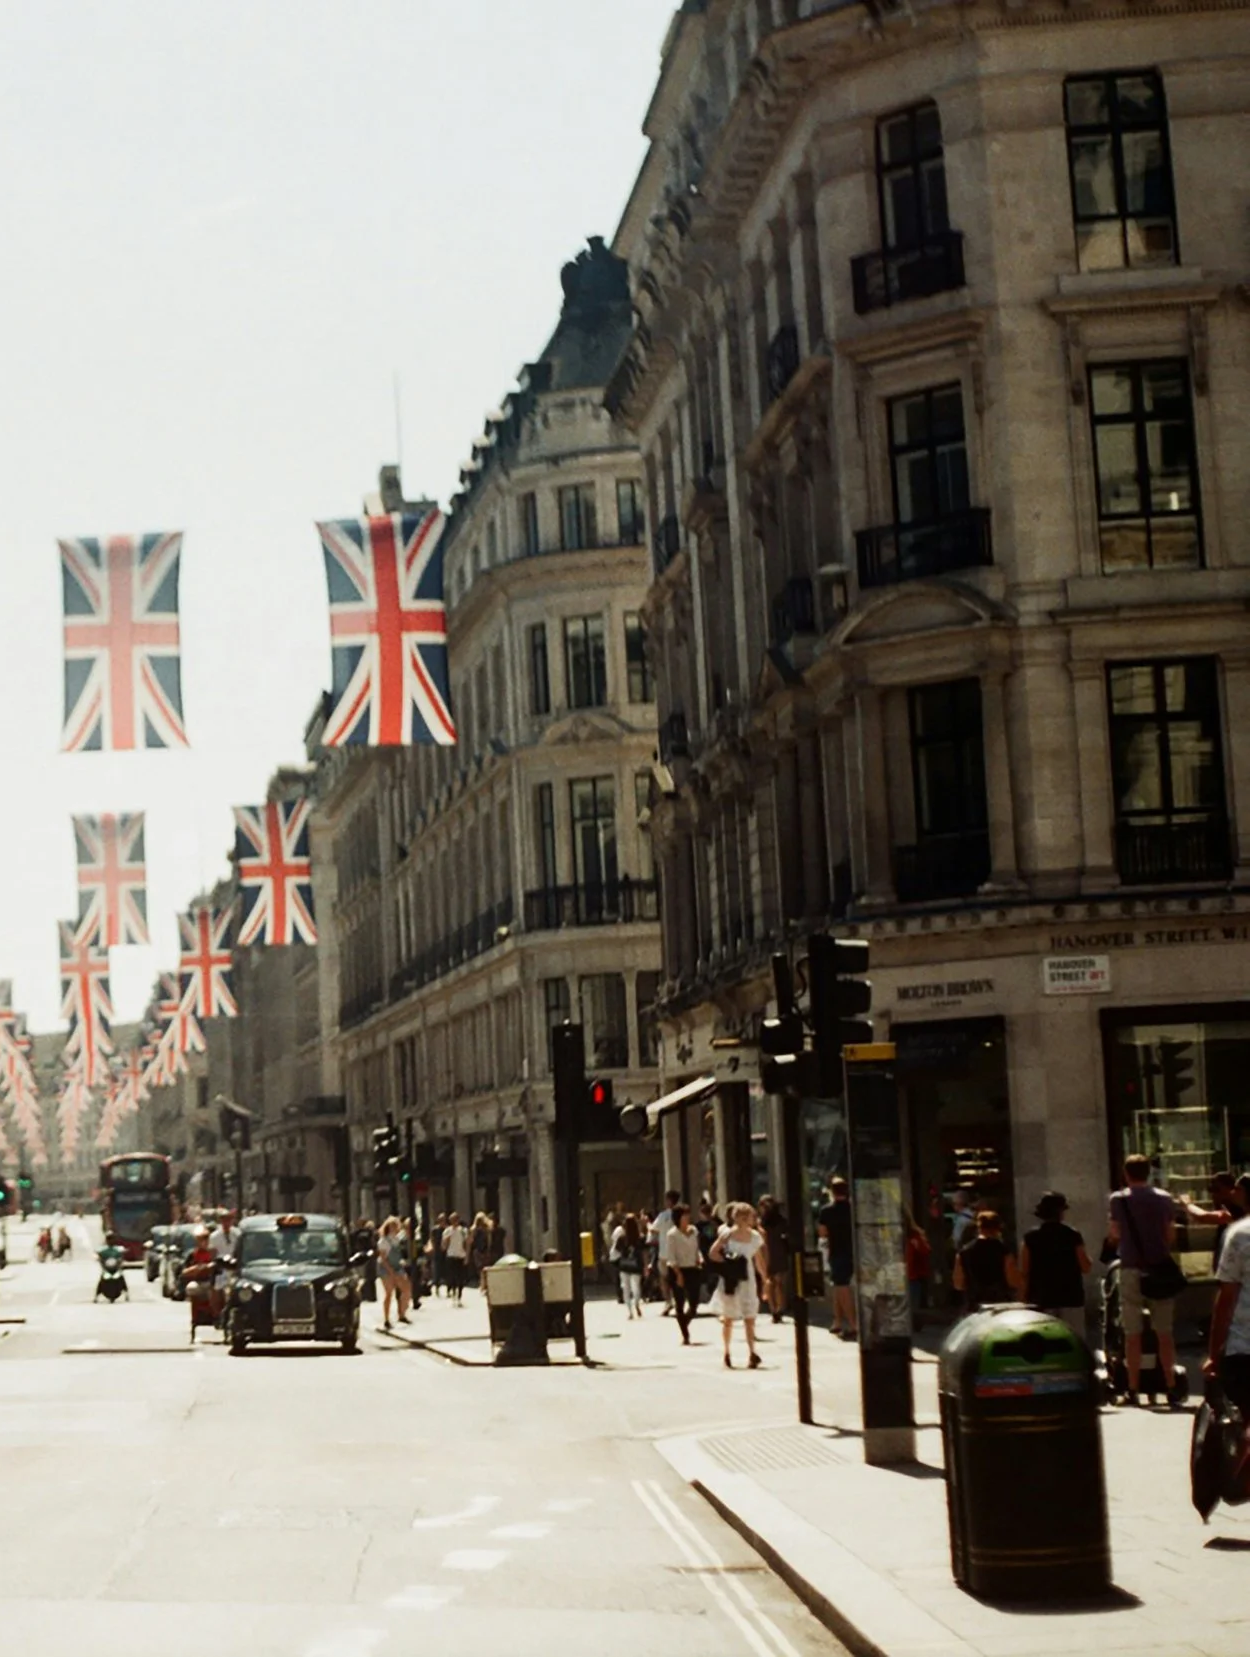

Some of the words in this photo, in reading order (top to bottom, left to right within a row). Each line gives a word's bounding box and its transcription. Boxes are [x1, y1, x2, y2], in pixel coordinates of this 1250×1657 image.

[1050, 932, 1134, 949] HANOVER
[1048, 958, 1096, 970] HANOVER
[1049, 971, 1086, 982] STREET
